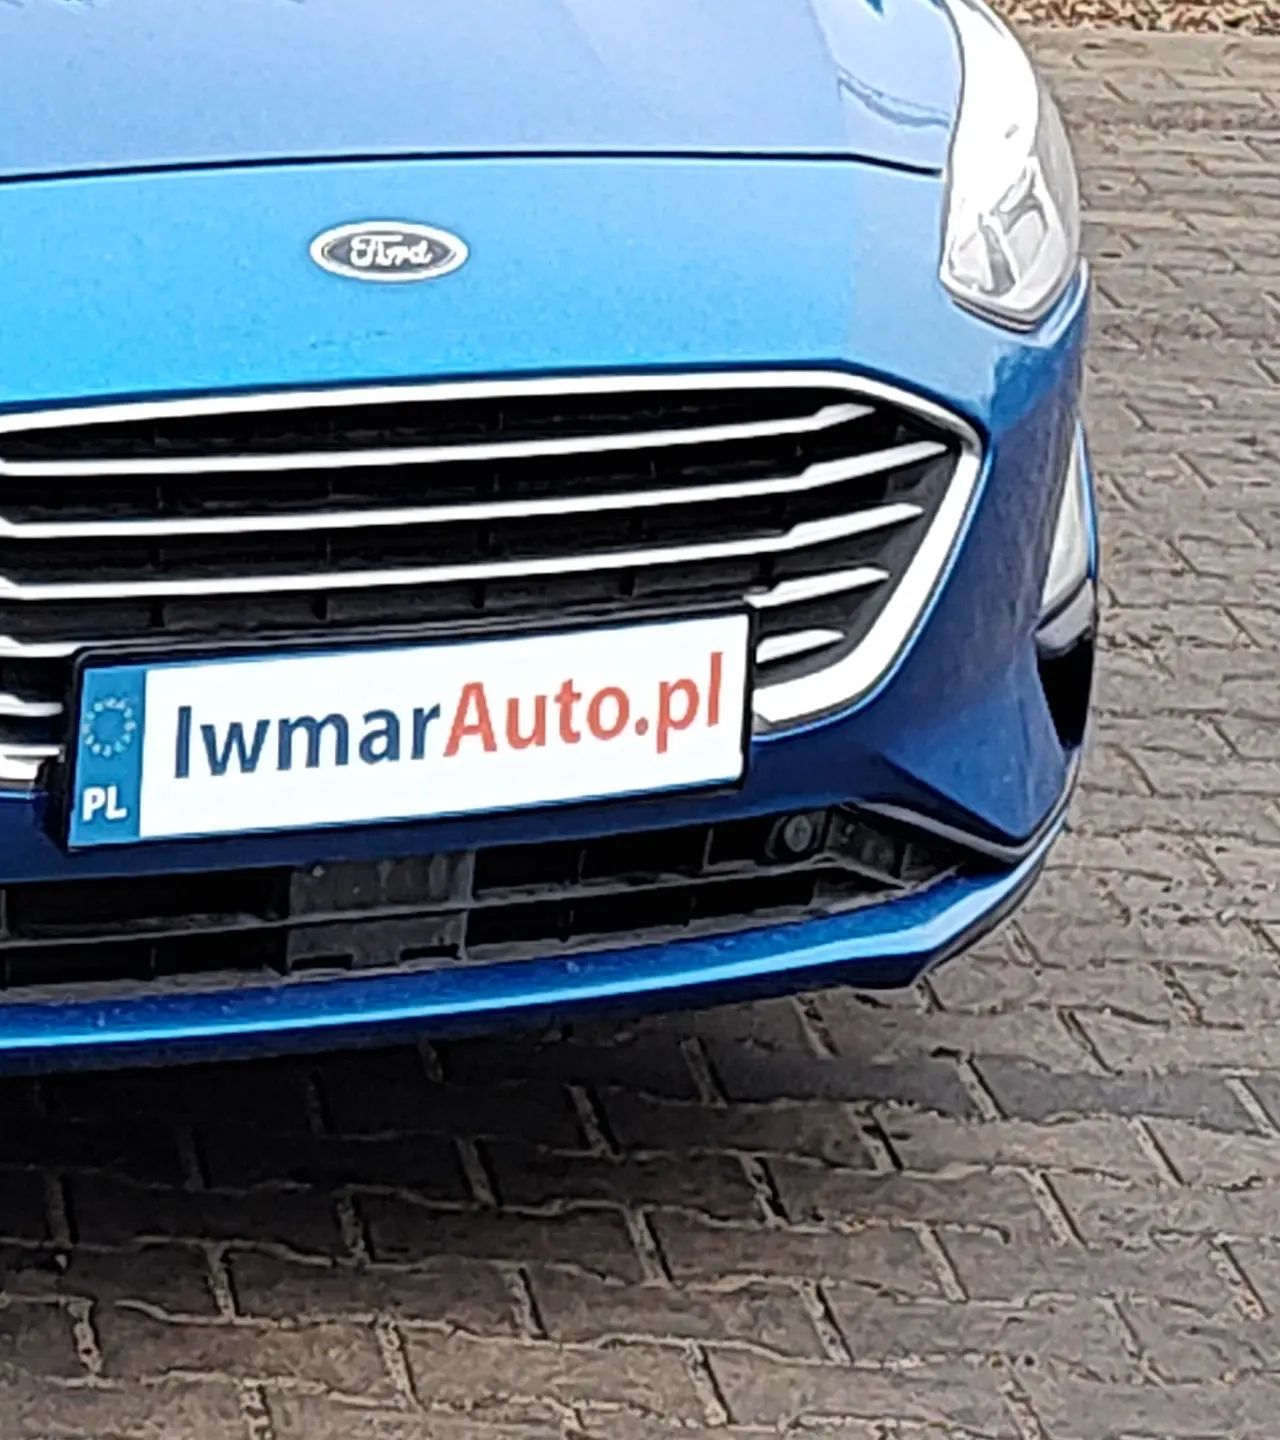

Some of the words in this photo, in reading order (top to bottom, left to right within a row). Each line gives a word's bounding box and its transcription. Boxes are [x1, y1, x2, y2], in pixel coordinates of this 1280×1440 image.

[350, 234, 433, 267] Ford
[173, 652, 723, 778] IwmarAuto.pl
[83, 785, 127, 821] PL
